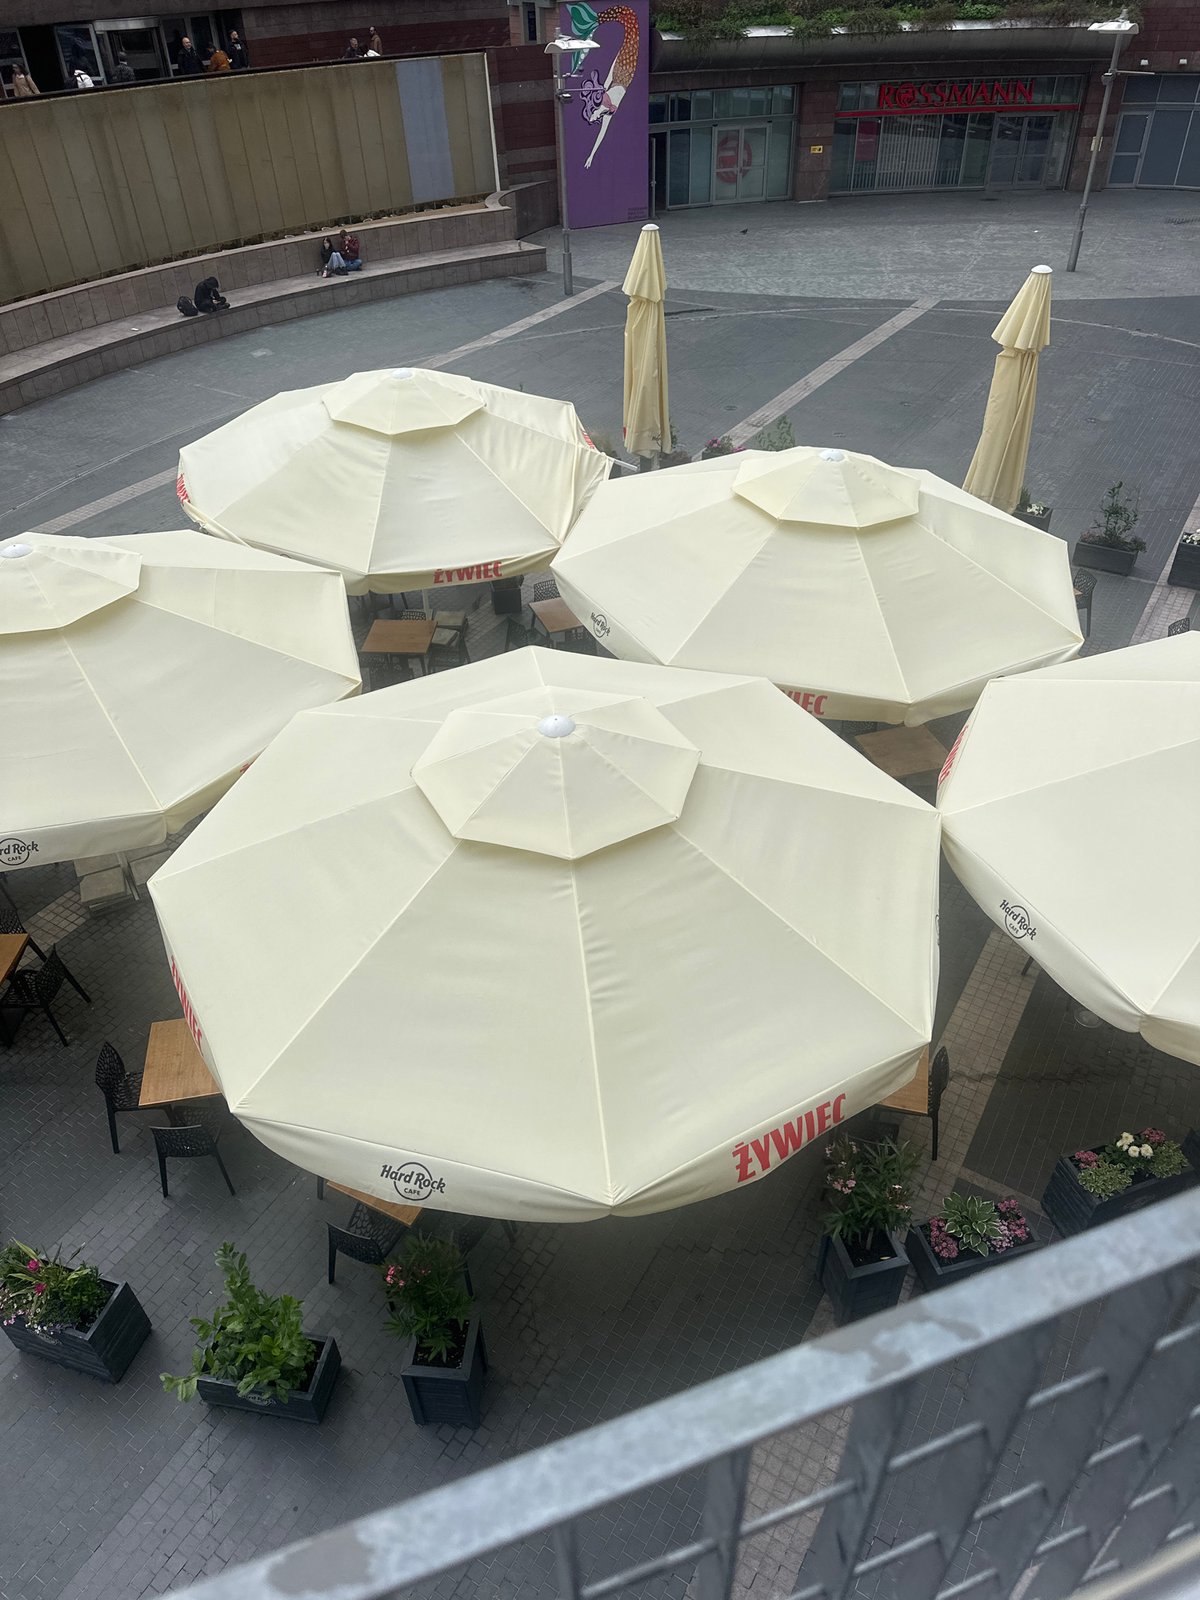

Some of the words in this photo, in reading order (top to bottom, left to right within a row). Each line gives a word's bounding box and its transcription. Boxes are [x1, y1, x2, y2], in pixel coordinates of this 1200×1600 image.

[879, 80, 1035, 109] ROSSMANN
[433, 560, 503, 584] ŻYWIEC
[780, 688, 828, 716] IEC
[12, 841, 40, 855] Rock
[1000, 899, 1021, 921] Hard
[1017, 916, 1037, 941] Rock
[731, 1093, 847, 1183] ŻYWIEC
[380, 1164, 415, 1184] Hard
[414, 1172, 447, 1194] Rock
[403, 1187, 421, 1196] CAFE
